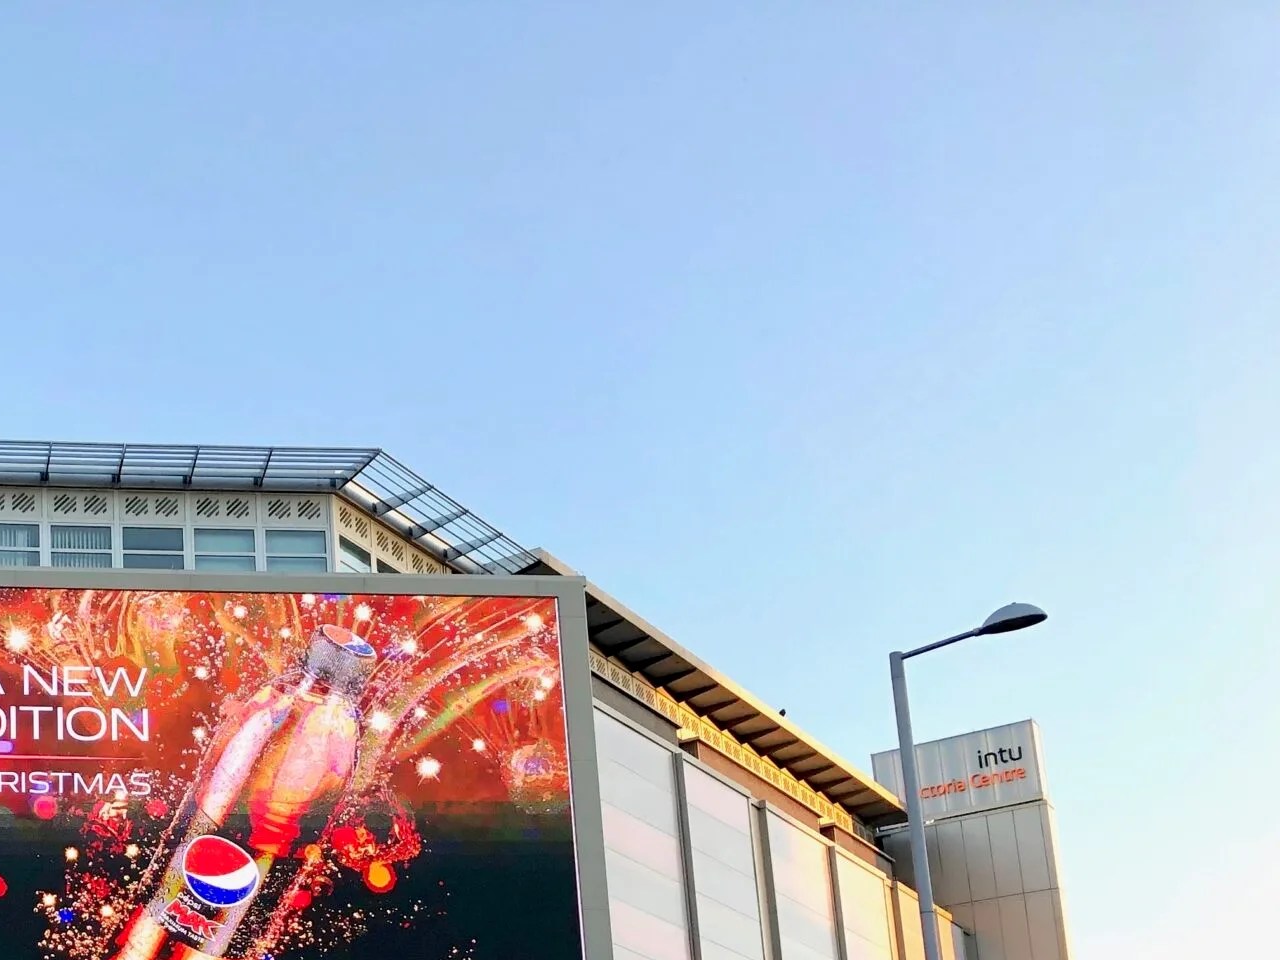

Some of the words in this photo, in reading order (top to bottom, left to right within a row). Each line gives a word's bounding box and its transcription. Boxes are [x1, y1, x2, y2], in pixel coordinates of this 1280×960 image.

[23, 665, 148, 697] NEW
[977, 745, 1023, 768] intu
[918, 778, 966, 799] ctoria
[970, 767, 1026, 788] Centre
[164, 898, 225, 941] MAX
